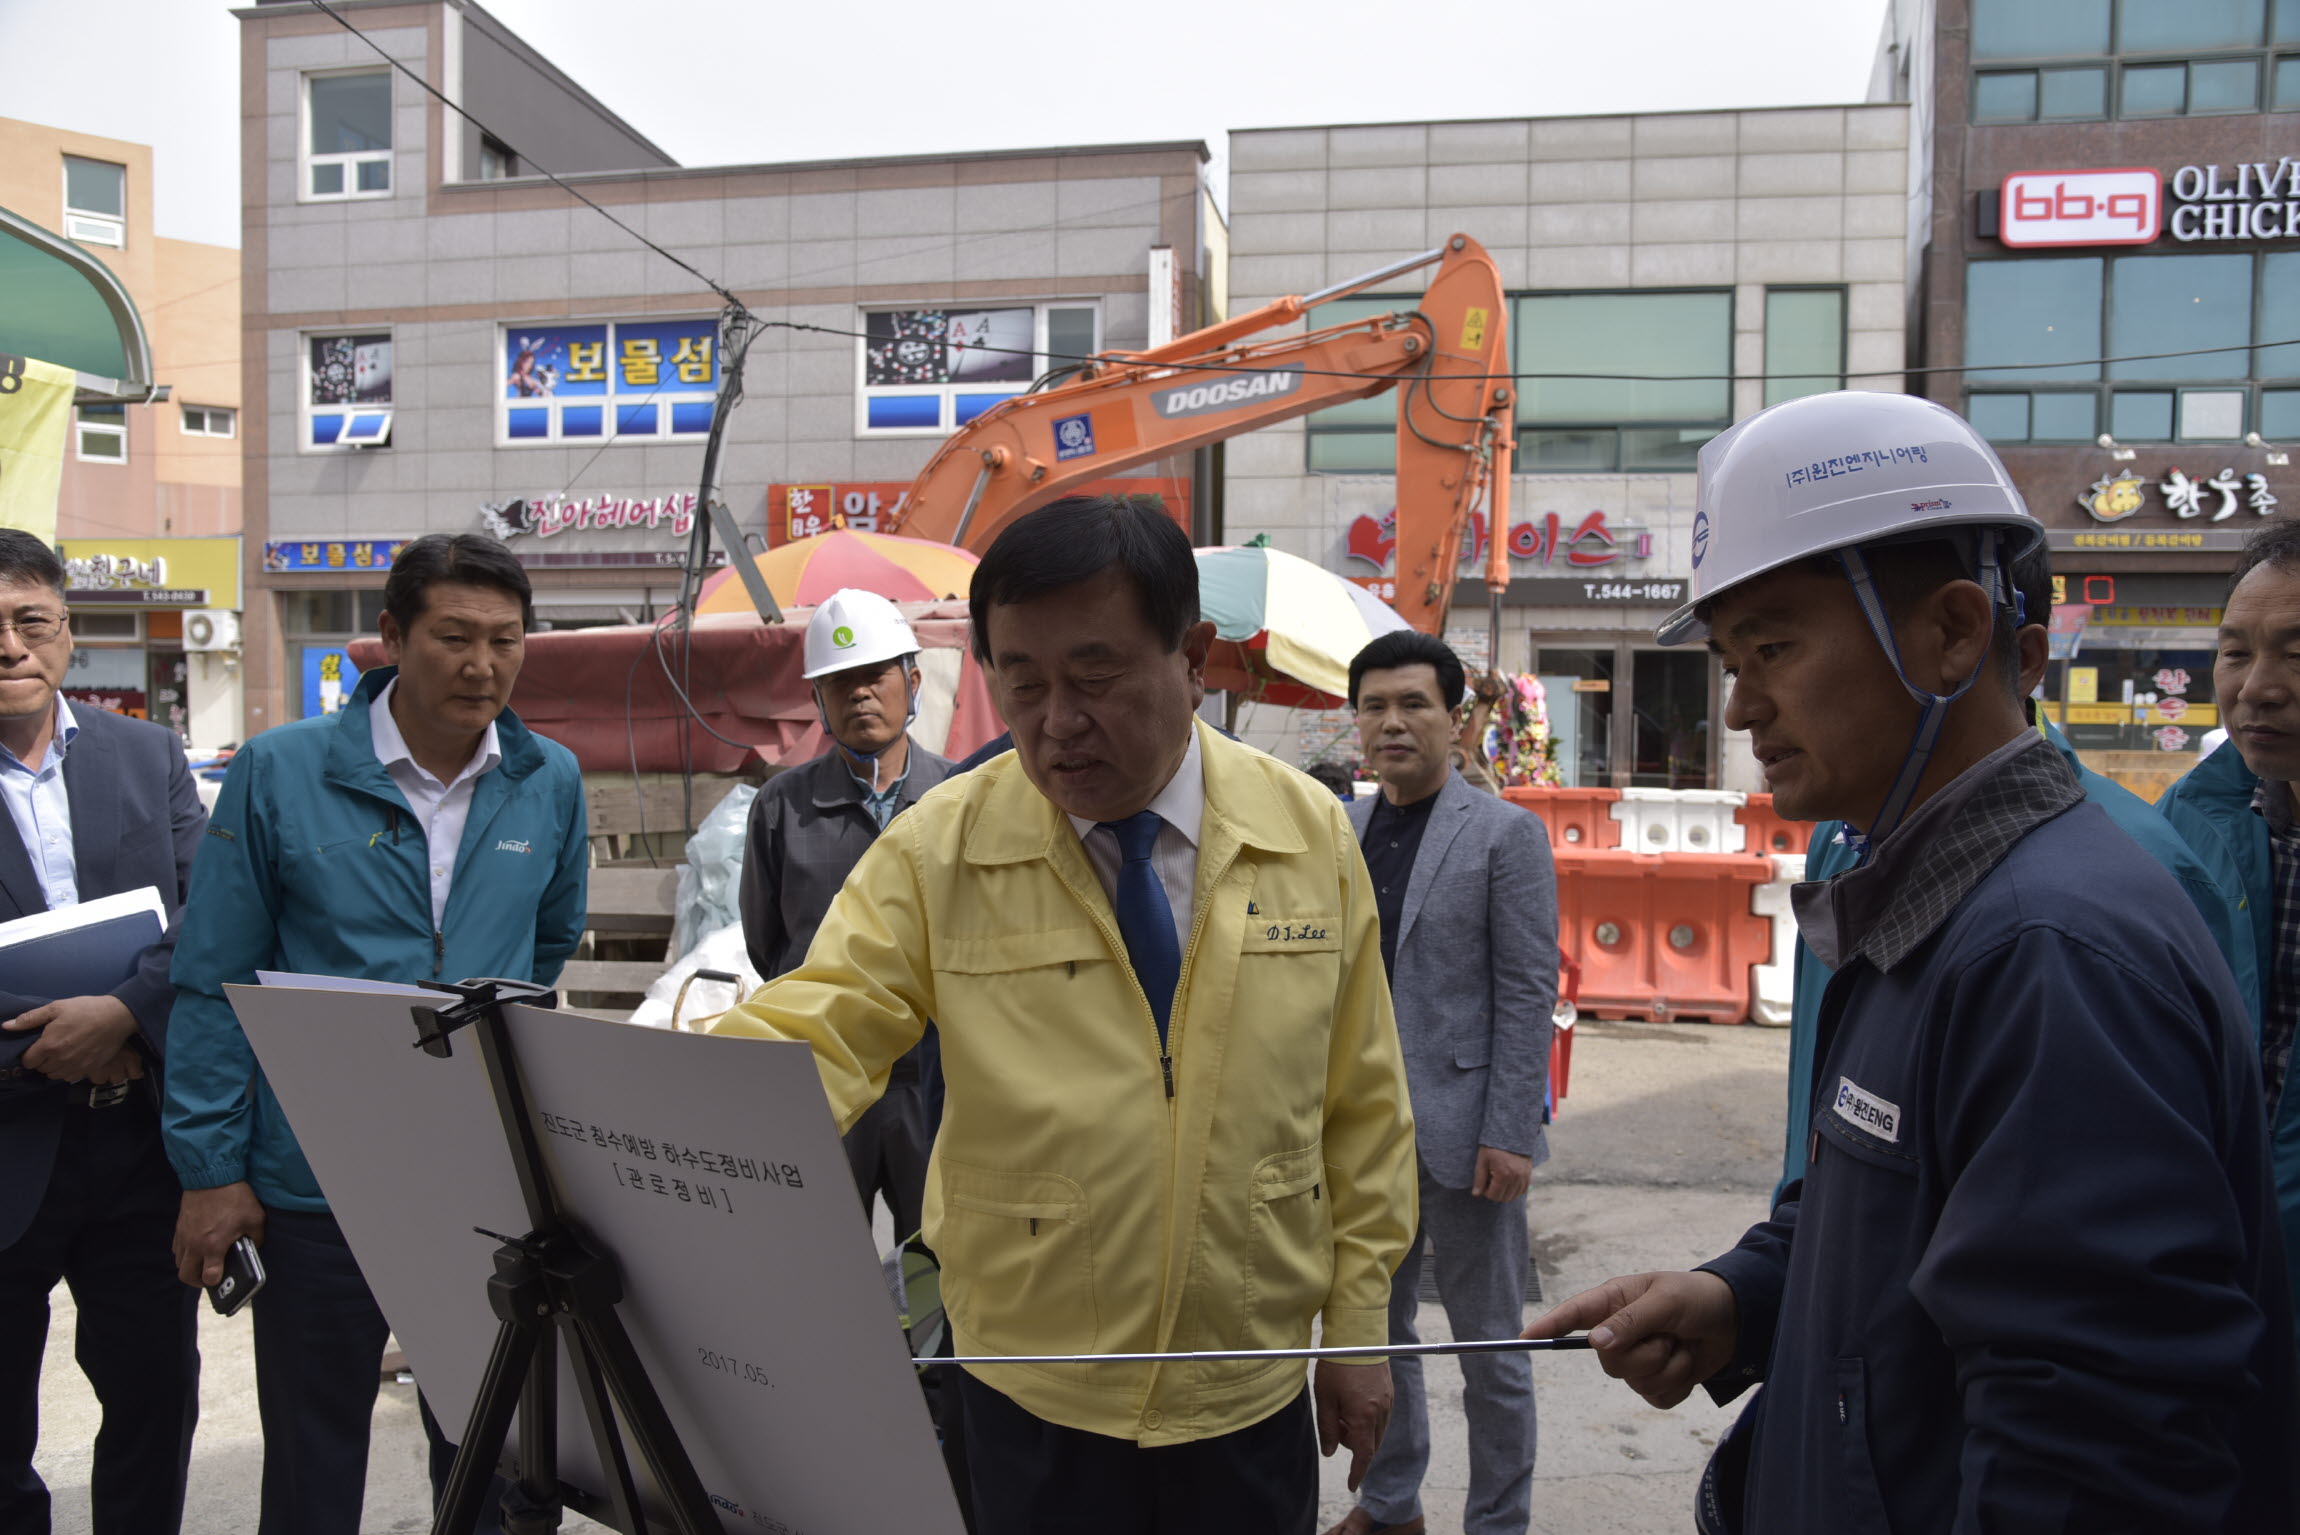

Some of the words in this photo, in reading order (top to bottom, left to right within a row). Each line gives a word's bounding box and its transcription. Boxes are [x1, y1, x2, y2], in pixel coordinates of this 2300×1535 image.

[2172, 156, 2300, 201] OLIVE
[2171, 202, 2300, 242] CHICK
[565, 336, 713, 385] 보물섬
[1165, 371, 1292, 414] DOOSAN
[528, 491, 697, 539] 진아헤어샵
[300, 542, 374, 569] 보물섬
[541, 1111, 588, 1143] 진도군
[590, 1124, 658, 1162] 침수예방
[661, 1142, 805, 1189] 하수도정비사업
